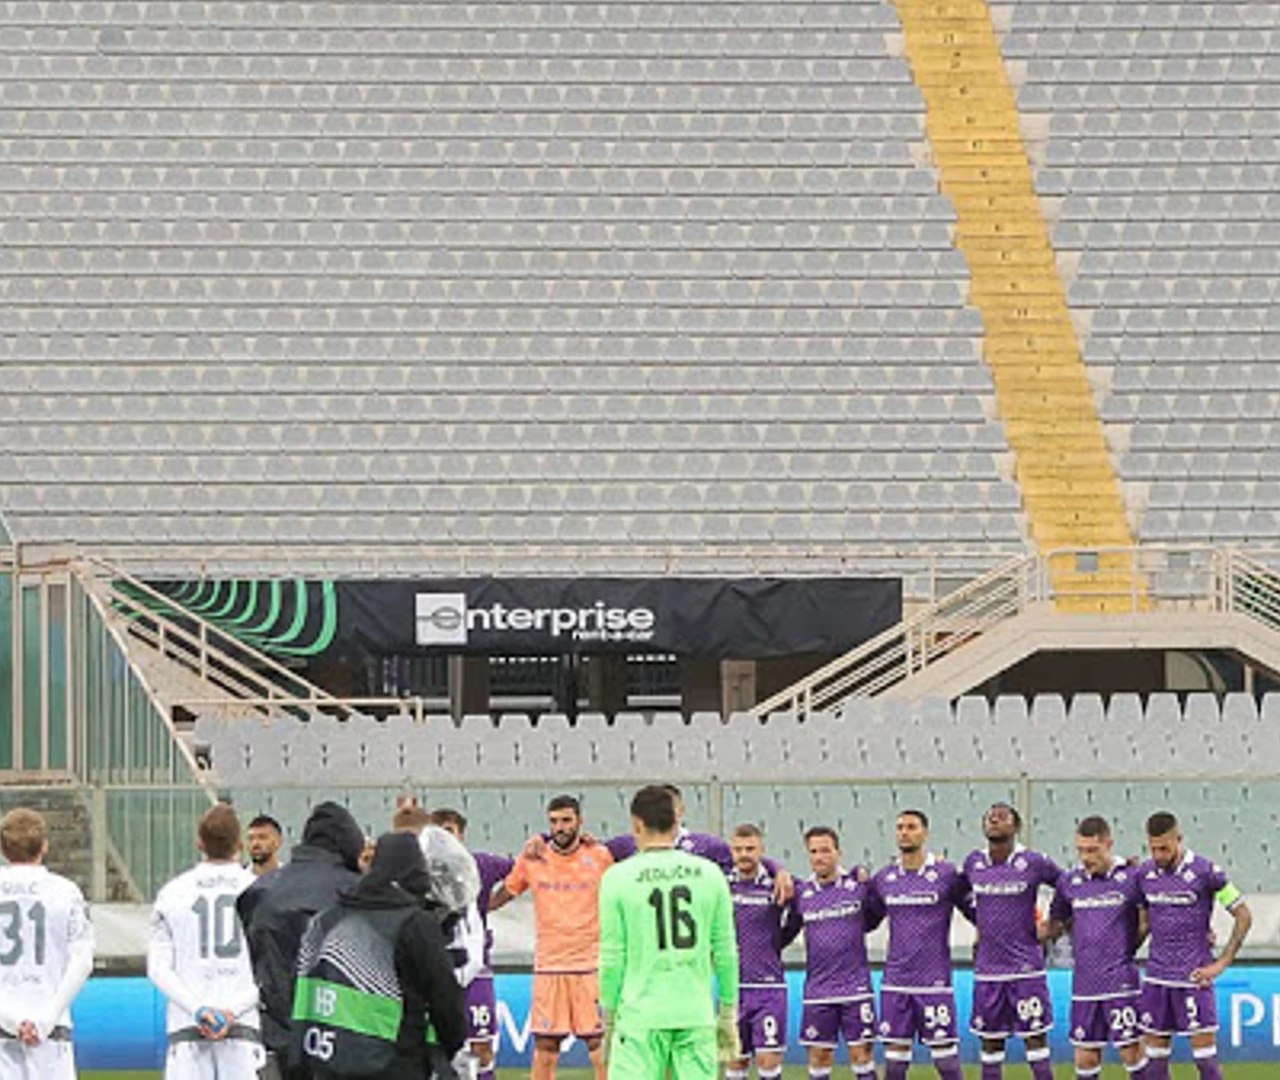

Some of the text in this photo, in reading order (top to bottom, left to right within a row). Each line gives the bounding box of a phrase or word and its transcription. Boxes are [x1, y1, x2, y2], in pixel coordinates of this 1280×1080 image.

[191, 894, 243, 959] 10
[648, 885, 697, 950] 16
[469, 1004, 491, 1027] 16
[860, 1002, 874, 1023] 6
[1111, 1006, 1138, 1030] 20
